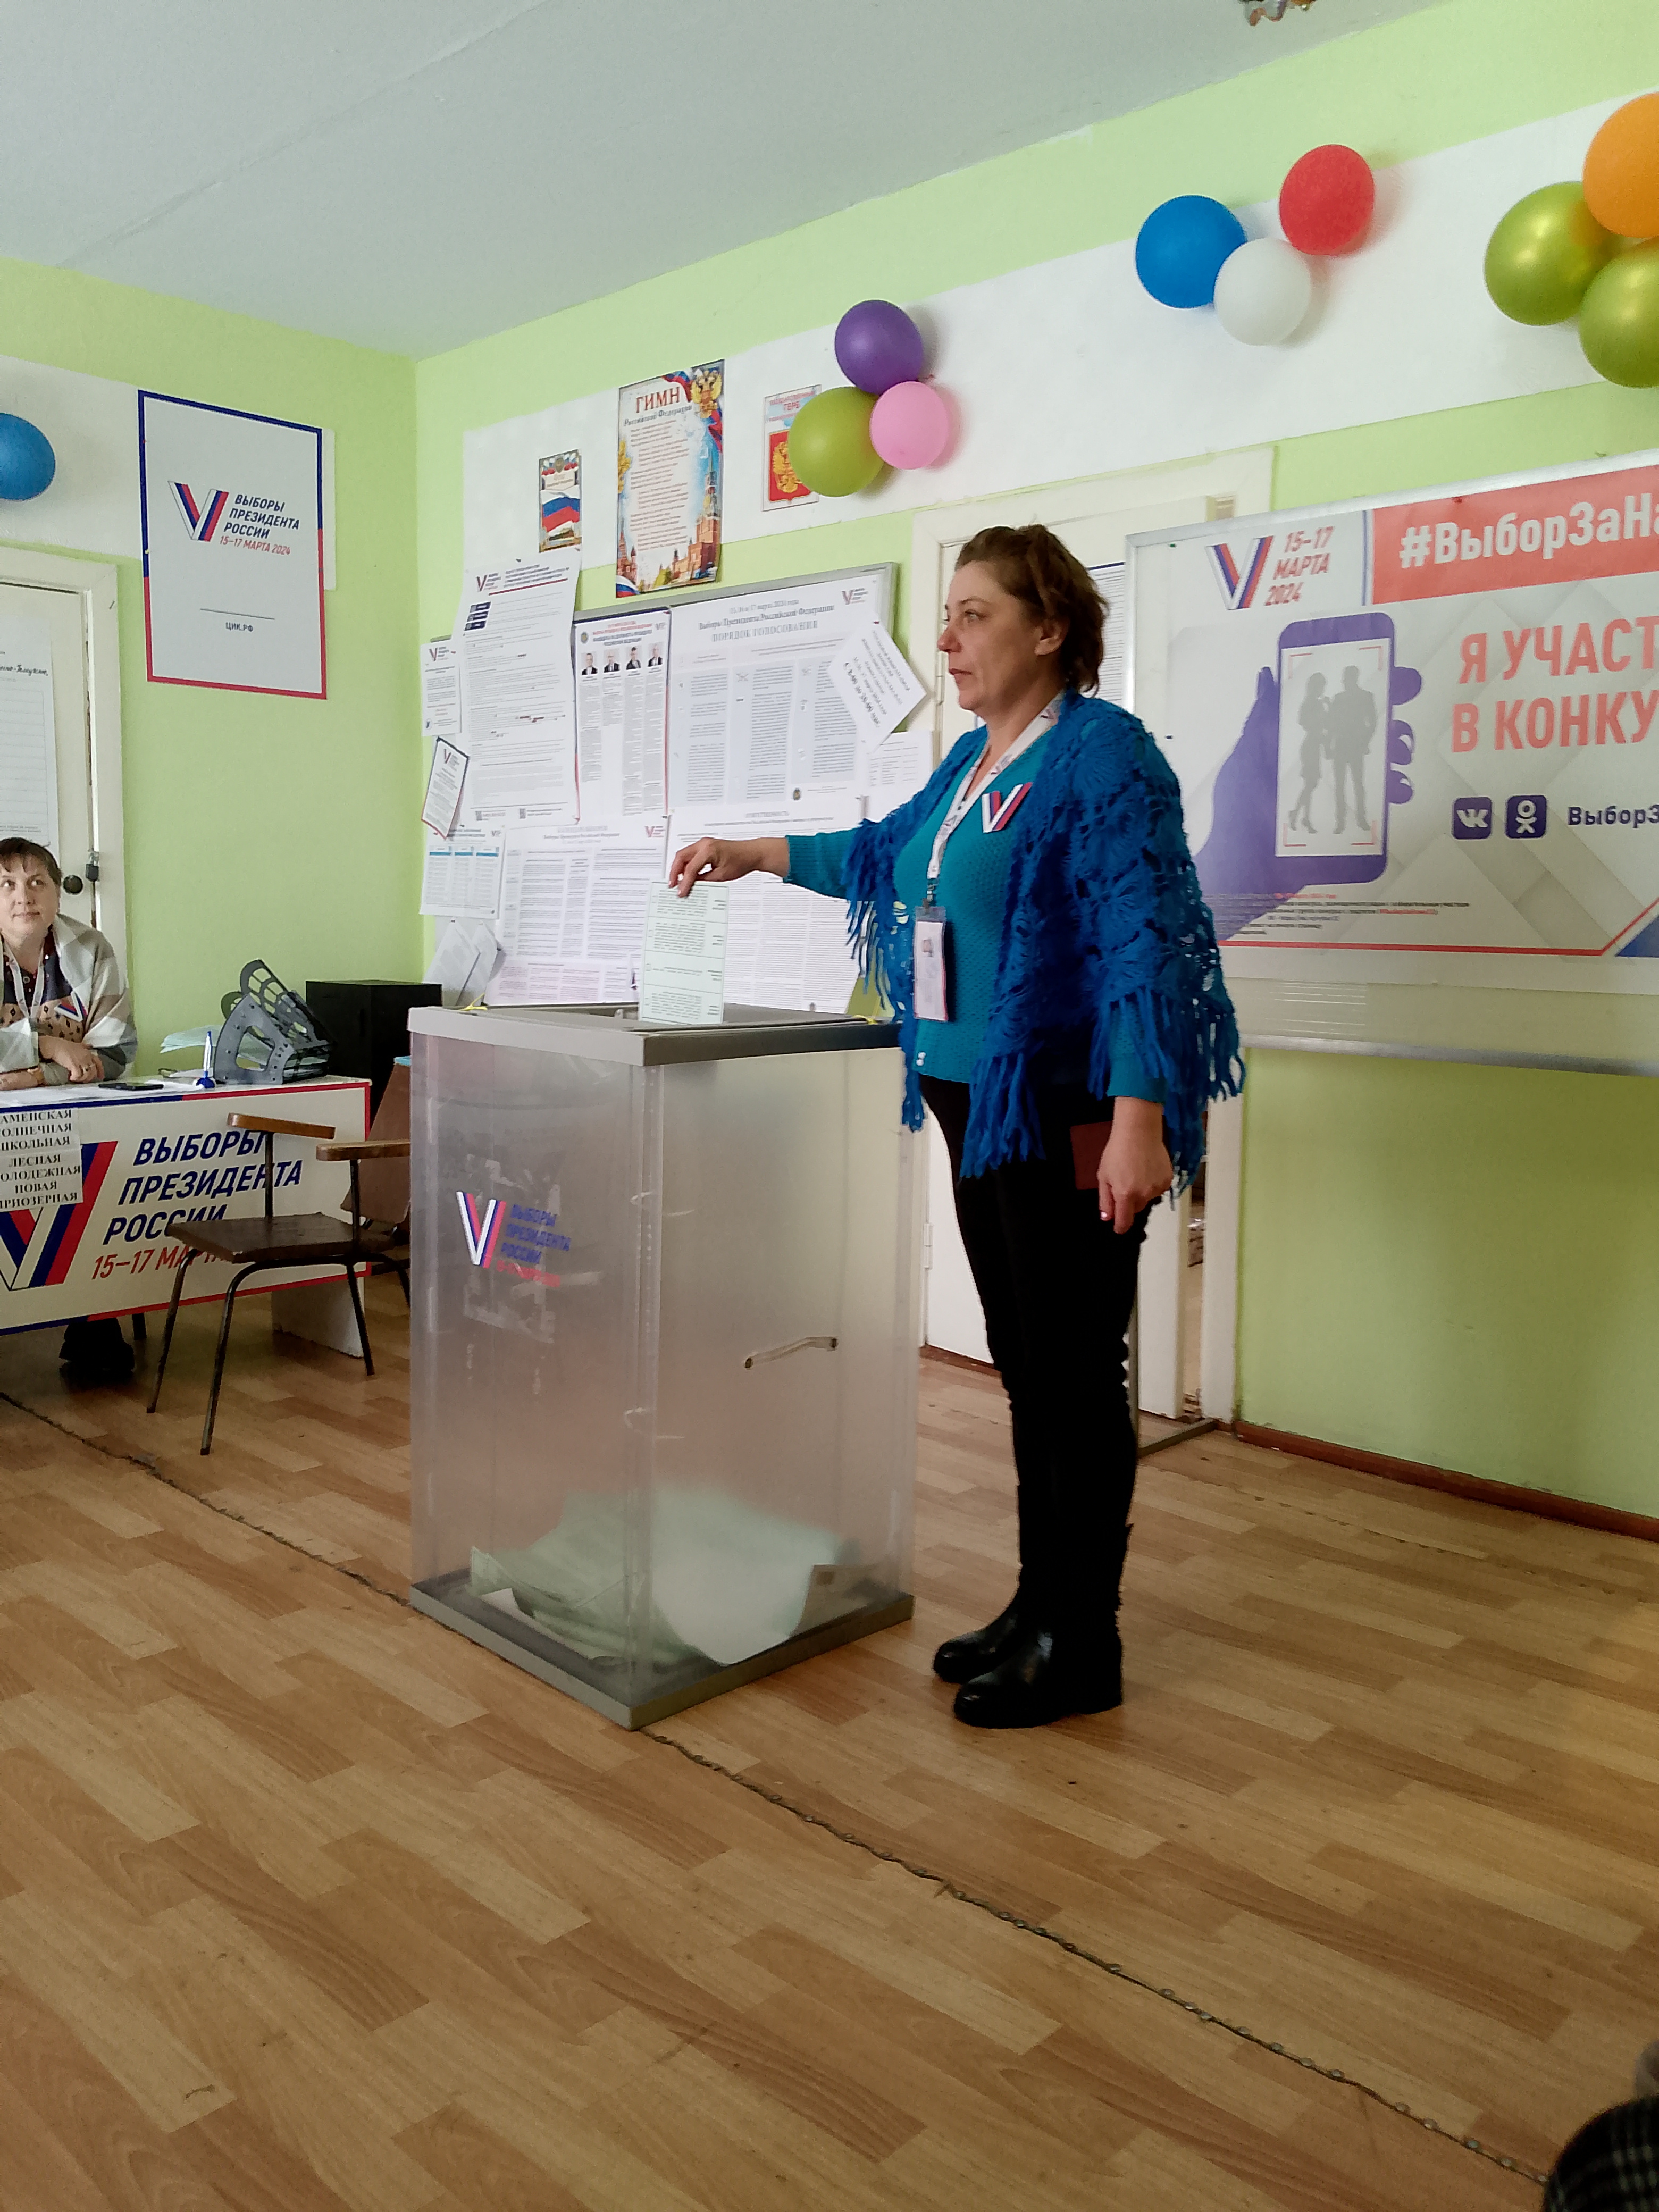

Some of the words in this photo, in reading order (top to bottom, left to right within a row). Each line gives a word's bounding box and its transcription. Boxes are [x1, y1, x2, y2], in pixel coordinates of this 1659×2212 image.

[636, 386, 680, 414] ГИМН
[235, 494, 285, 513] ВЫБОРЫ
[223, 522, 270, 539] РОССИИ
[229, 508, 300, 530] ПРЕЗИДЕНТА
[243, 539, 270, 552] МАРТА
[271, 544, 290, 556] 2024
[1284, 526, 1335, 553] 15-17
[1273, 552, 1330, 580] МАРТА
[1264, 582, 1304, 606] 2024
[1459, 633, 1487, 684] Я
[1502, 615, 1659, 681] УЧАСТ
[1452, 703, 1479, 753] В
[1495, 690, 1659, 751] КОНКУ
[133, 1129, 266, 1166] ВЫБОРЫ
[9, 1154, 61, 1168] ЛЕСНАЯ
[15, 1181, 57, 1194] НОВАЯ
